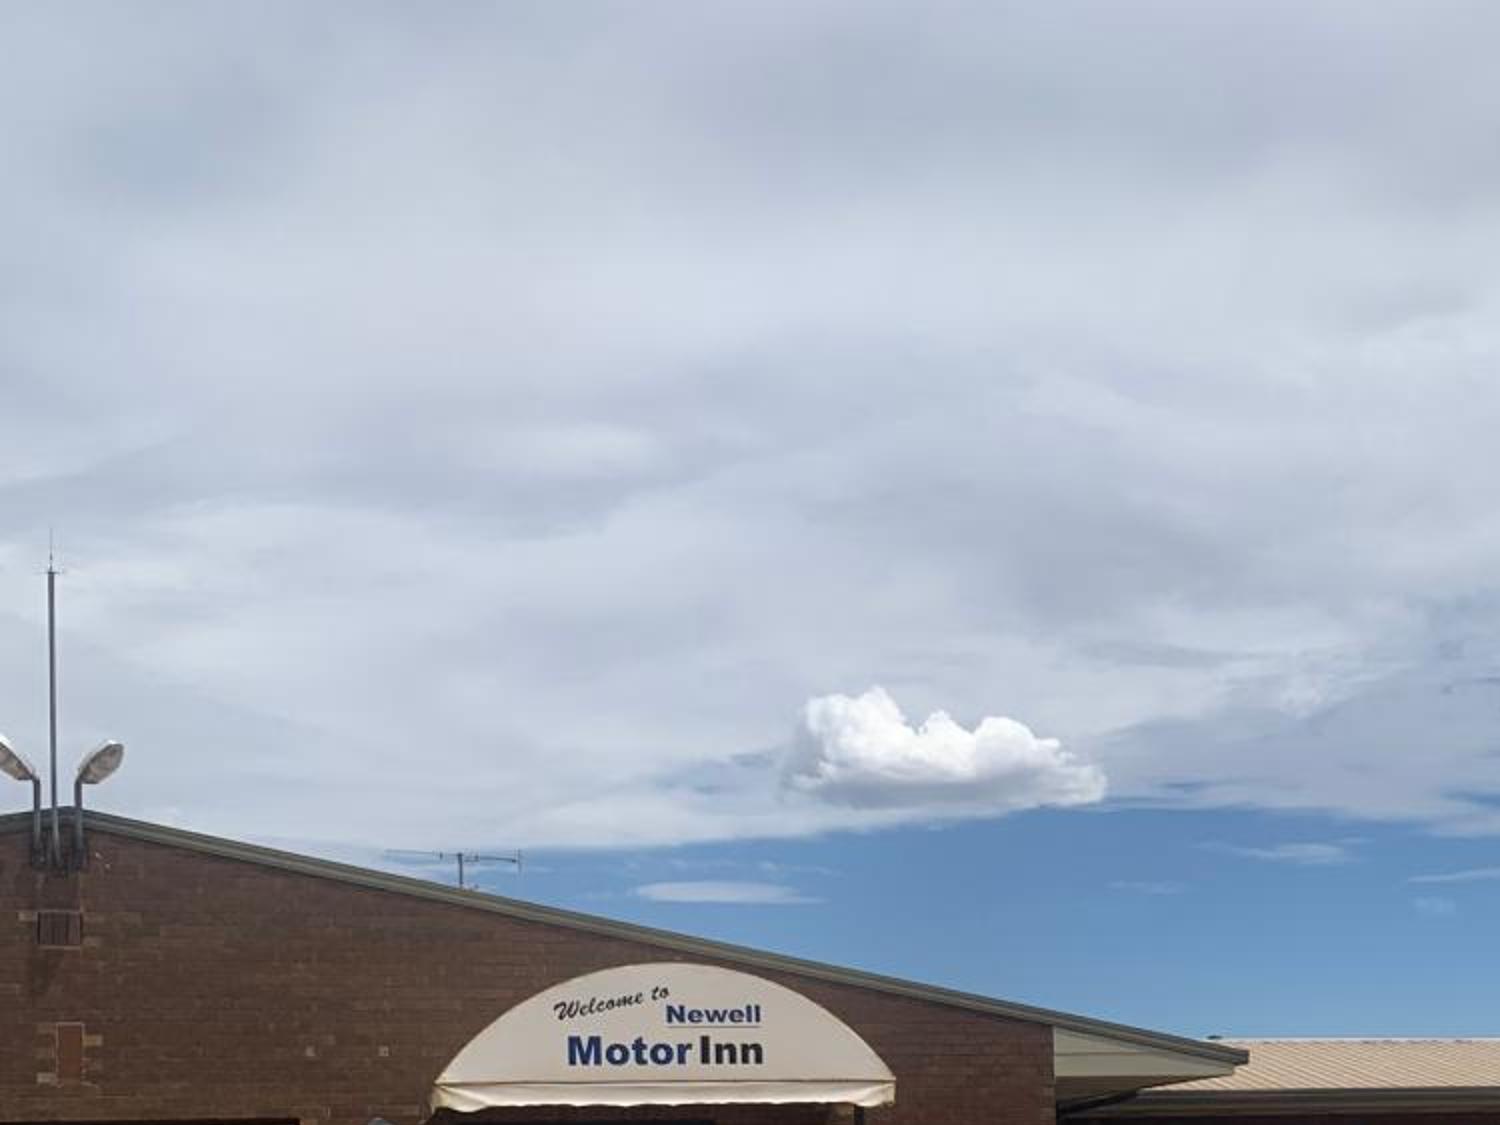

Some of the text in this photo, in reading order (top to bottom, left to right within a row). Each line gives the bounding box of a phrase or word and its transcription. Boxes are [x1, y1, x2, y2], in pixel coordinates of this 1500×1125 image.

[553, 985, 670, 1021] Welcome to
[666, 1004, 761, 1024] Newell
[567, 1035, 764, 1066] Motor Inn
